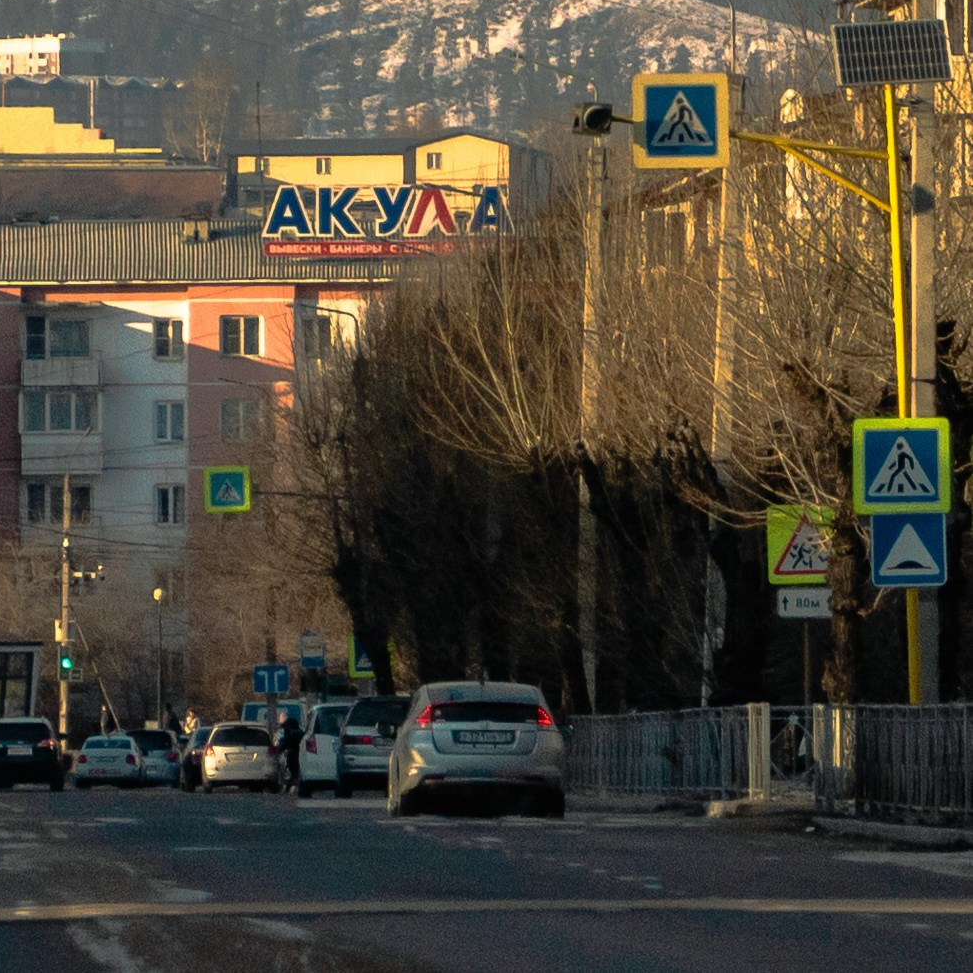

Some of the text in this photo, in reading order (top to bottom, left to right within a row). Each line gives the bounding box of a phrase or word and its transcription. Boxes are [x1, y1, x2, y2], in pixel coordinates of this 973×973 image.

[263, 184, 515, 237] АКУЛА
[269, 243, 322, 254] ВЫВЕСКИ
[329, 243, 383, 255] БАННЕРЫ
